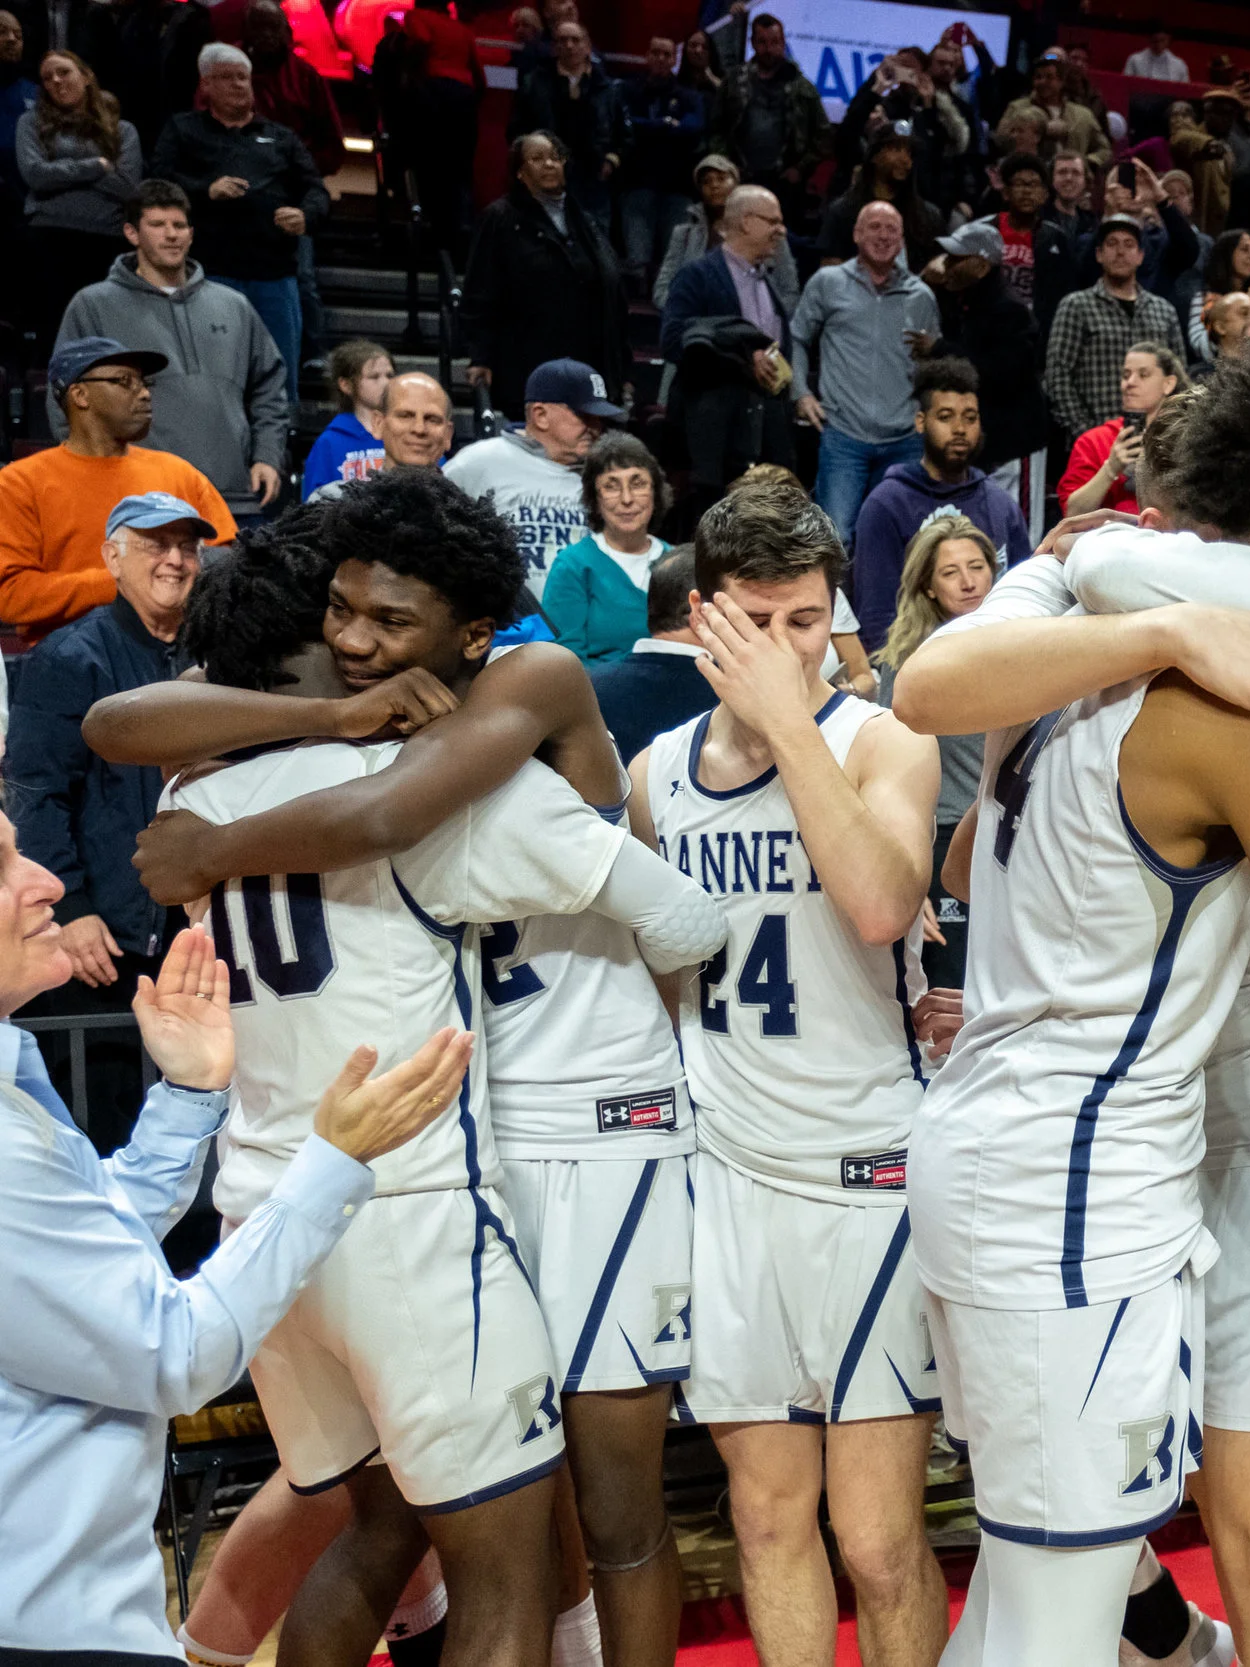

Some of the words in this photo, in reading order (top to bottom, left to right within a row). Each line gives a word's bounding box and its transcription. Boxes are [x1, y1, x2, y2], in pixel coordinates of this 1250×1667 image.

[650, 1283, 692, 1346] R
[504, 1372, 562, 1449] R
[1118, 1411, 1176, 1497] R
